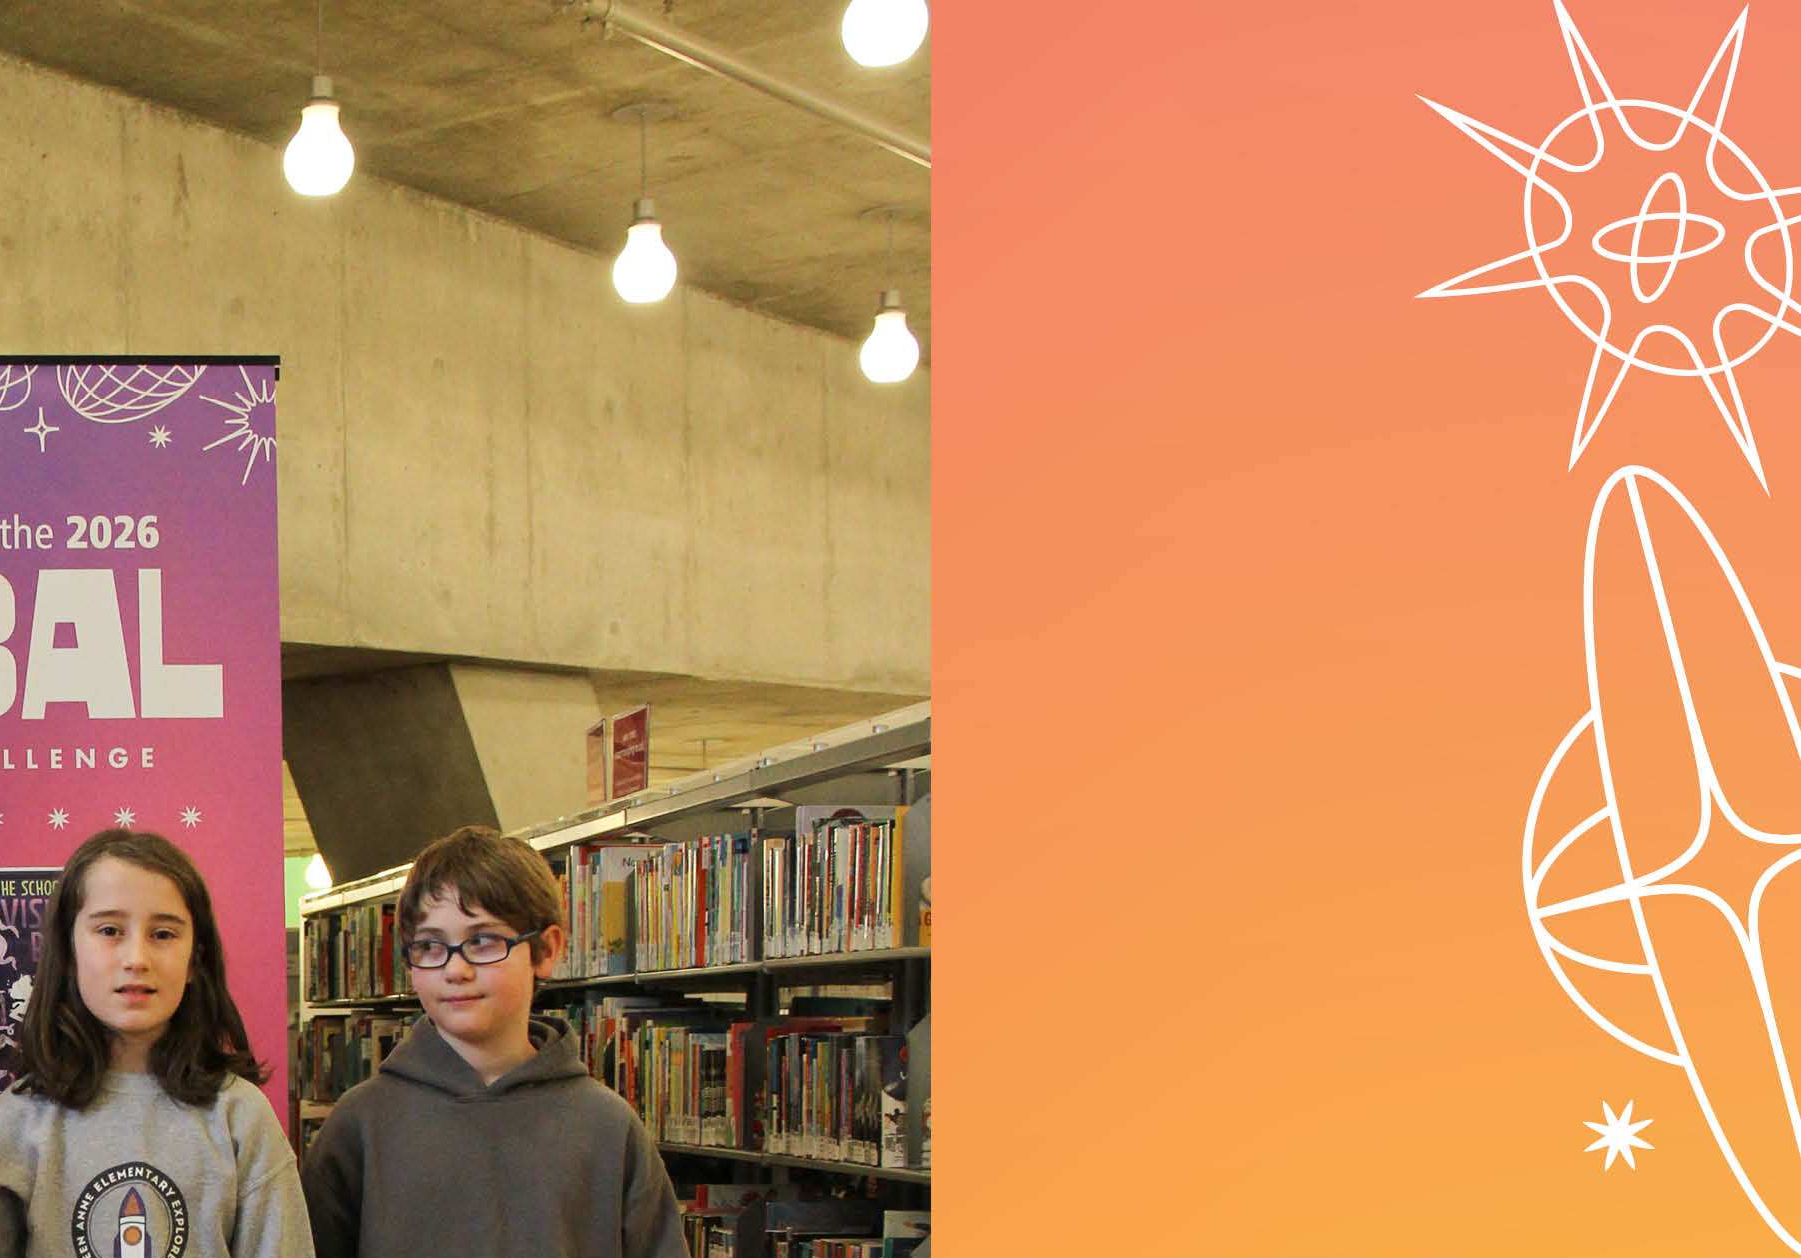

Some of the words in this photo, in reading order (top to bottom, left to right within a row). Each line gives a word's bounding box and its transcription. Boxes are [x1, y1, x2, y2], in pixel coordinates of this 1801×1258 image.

[65, 515, 160, 549] 2026
[20, 879, 58, 897] SCHO
[76, 1192, 94, 1230] ANNE
[93, 1166, 176, 1197] ELEMENTARY
